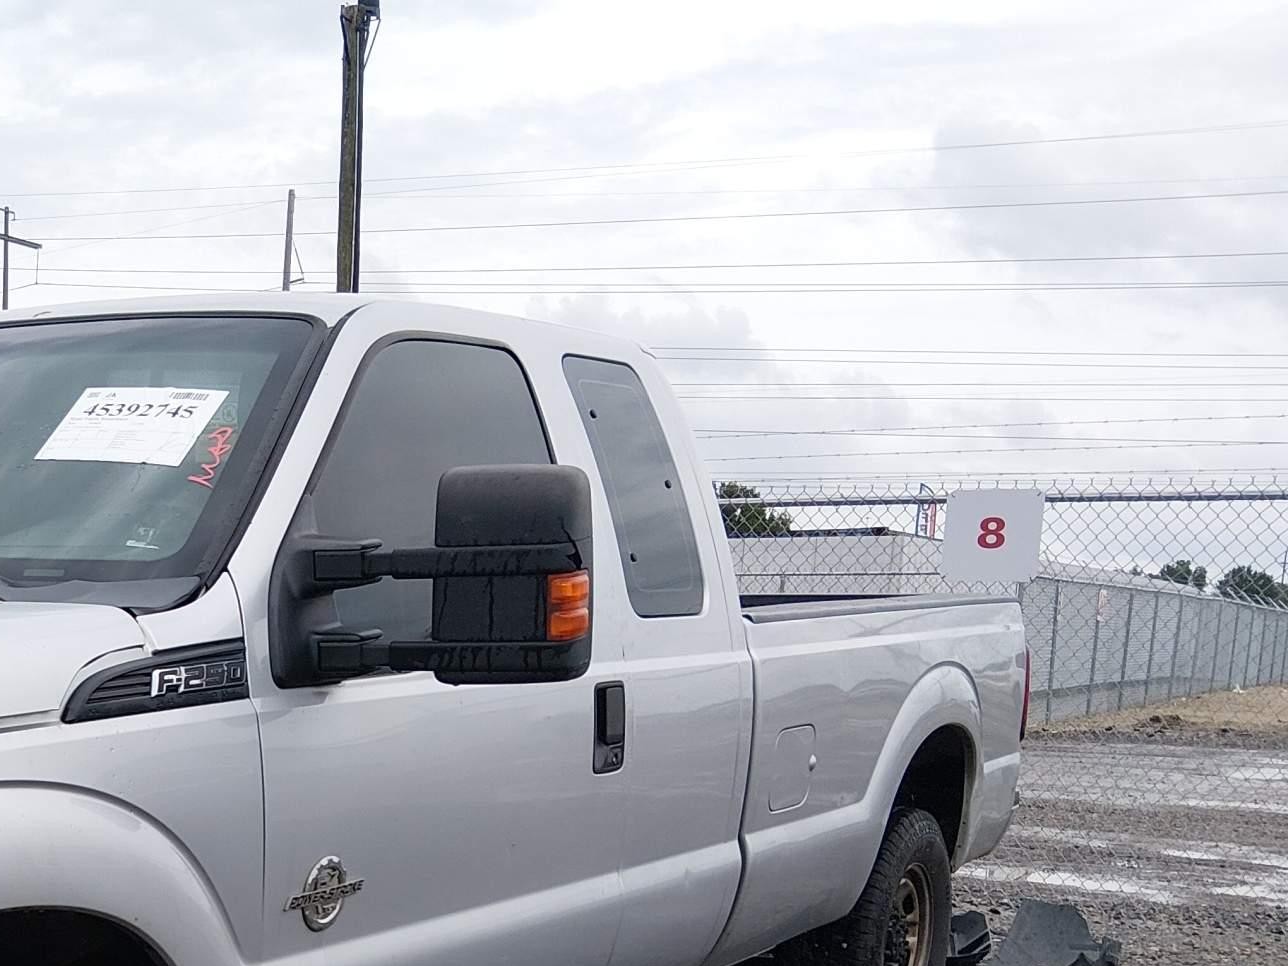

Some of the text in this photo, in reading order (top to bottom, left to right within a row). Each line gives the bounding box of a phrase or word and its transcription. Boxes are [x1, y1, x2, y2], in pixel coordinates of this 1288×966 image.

[83, 403, 199, 419] 45392745
[977, 516, 1006, 549] 8
[151, 661, 247, 698] F-250
